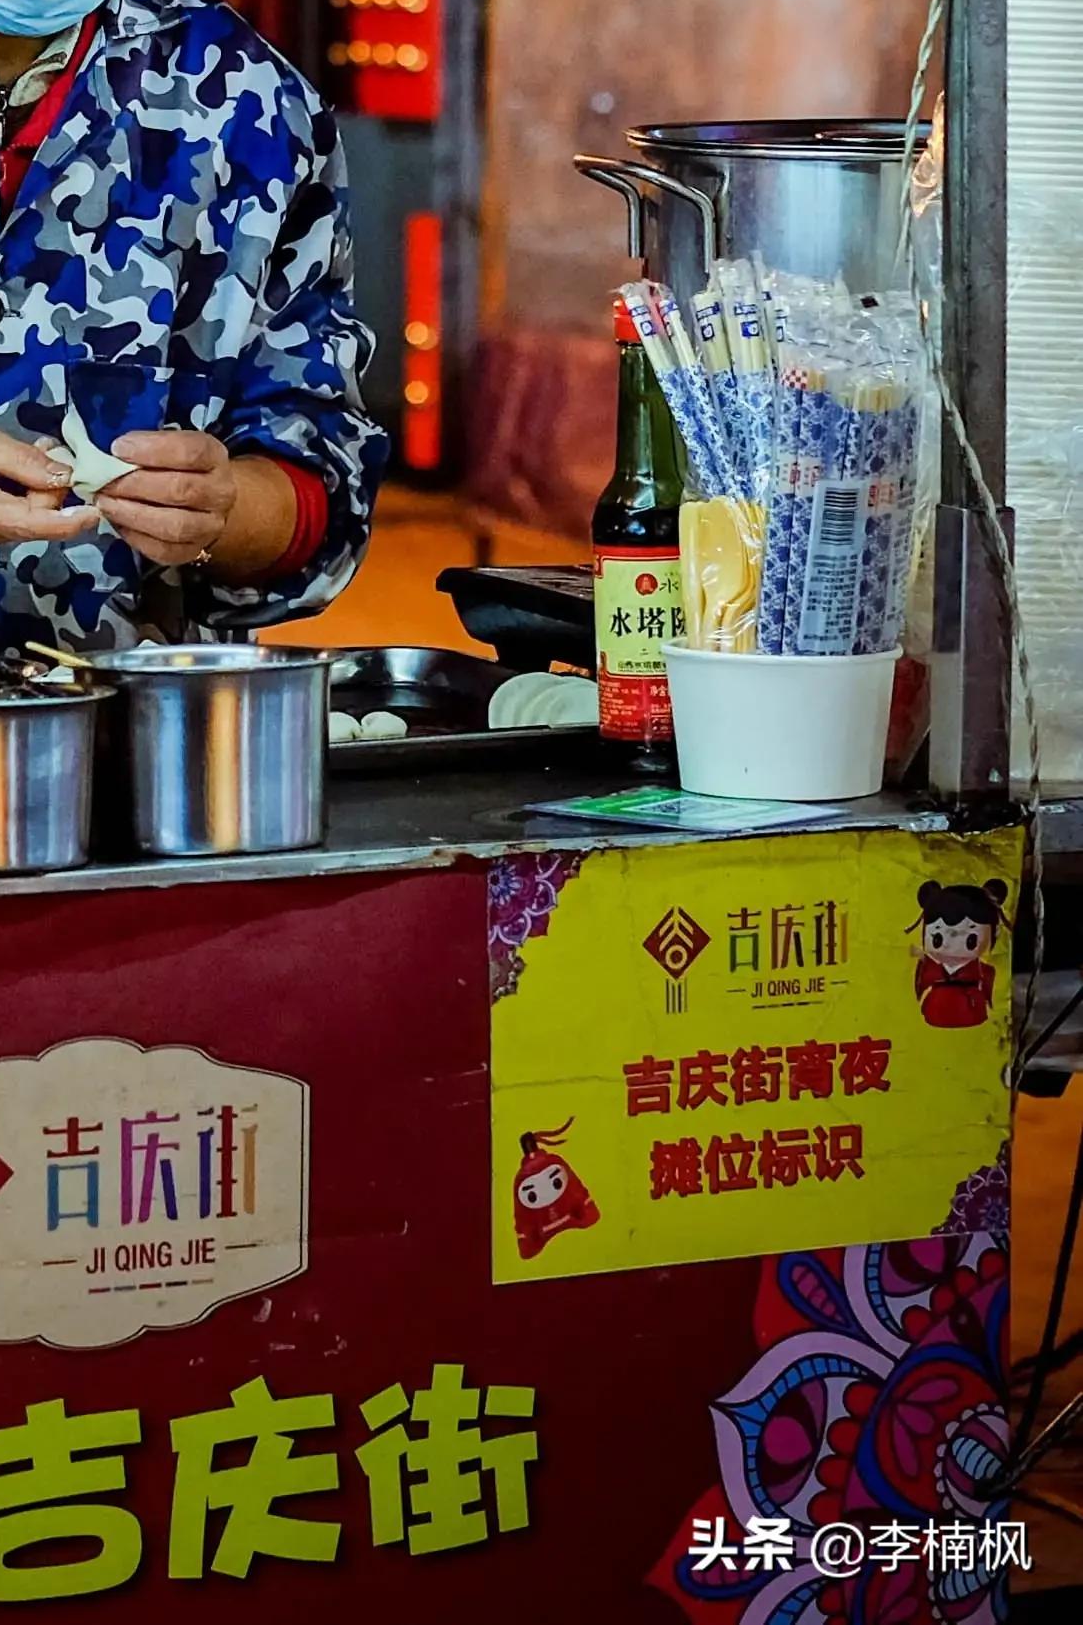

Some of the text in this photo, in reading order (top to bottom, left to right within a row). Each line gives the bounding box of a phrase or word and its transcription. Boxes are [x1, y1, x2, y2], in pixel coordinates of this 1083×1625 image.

[727, 899, 848, 973] 吉庆街
[751, 977, 825, 998] JI QING JIE
[623, 1035, 892, 1117] 吉庆街宵夜
[42, 1104, 258, 1232] 吉庆街
[650, 1124, 865, 1200] 摊位标识
[85, 1237, 216, 1274] JI QING JIE
